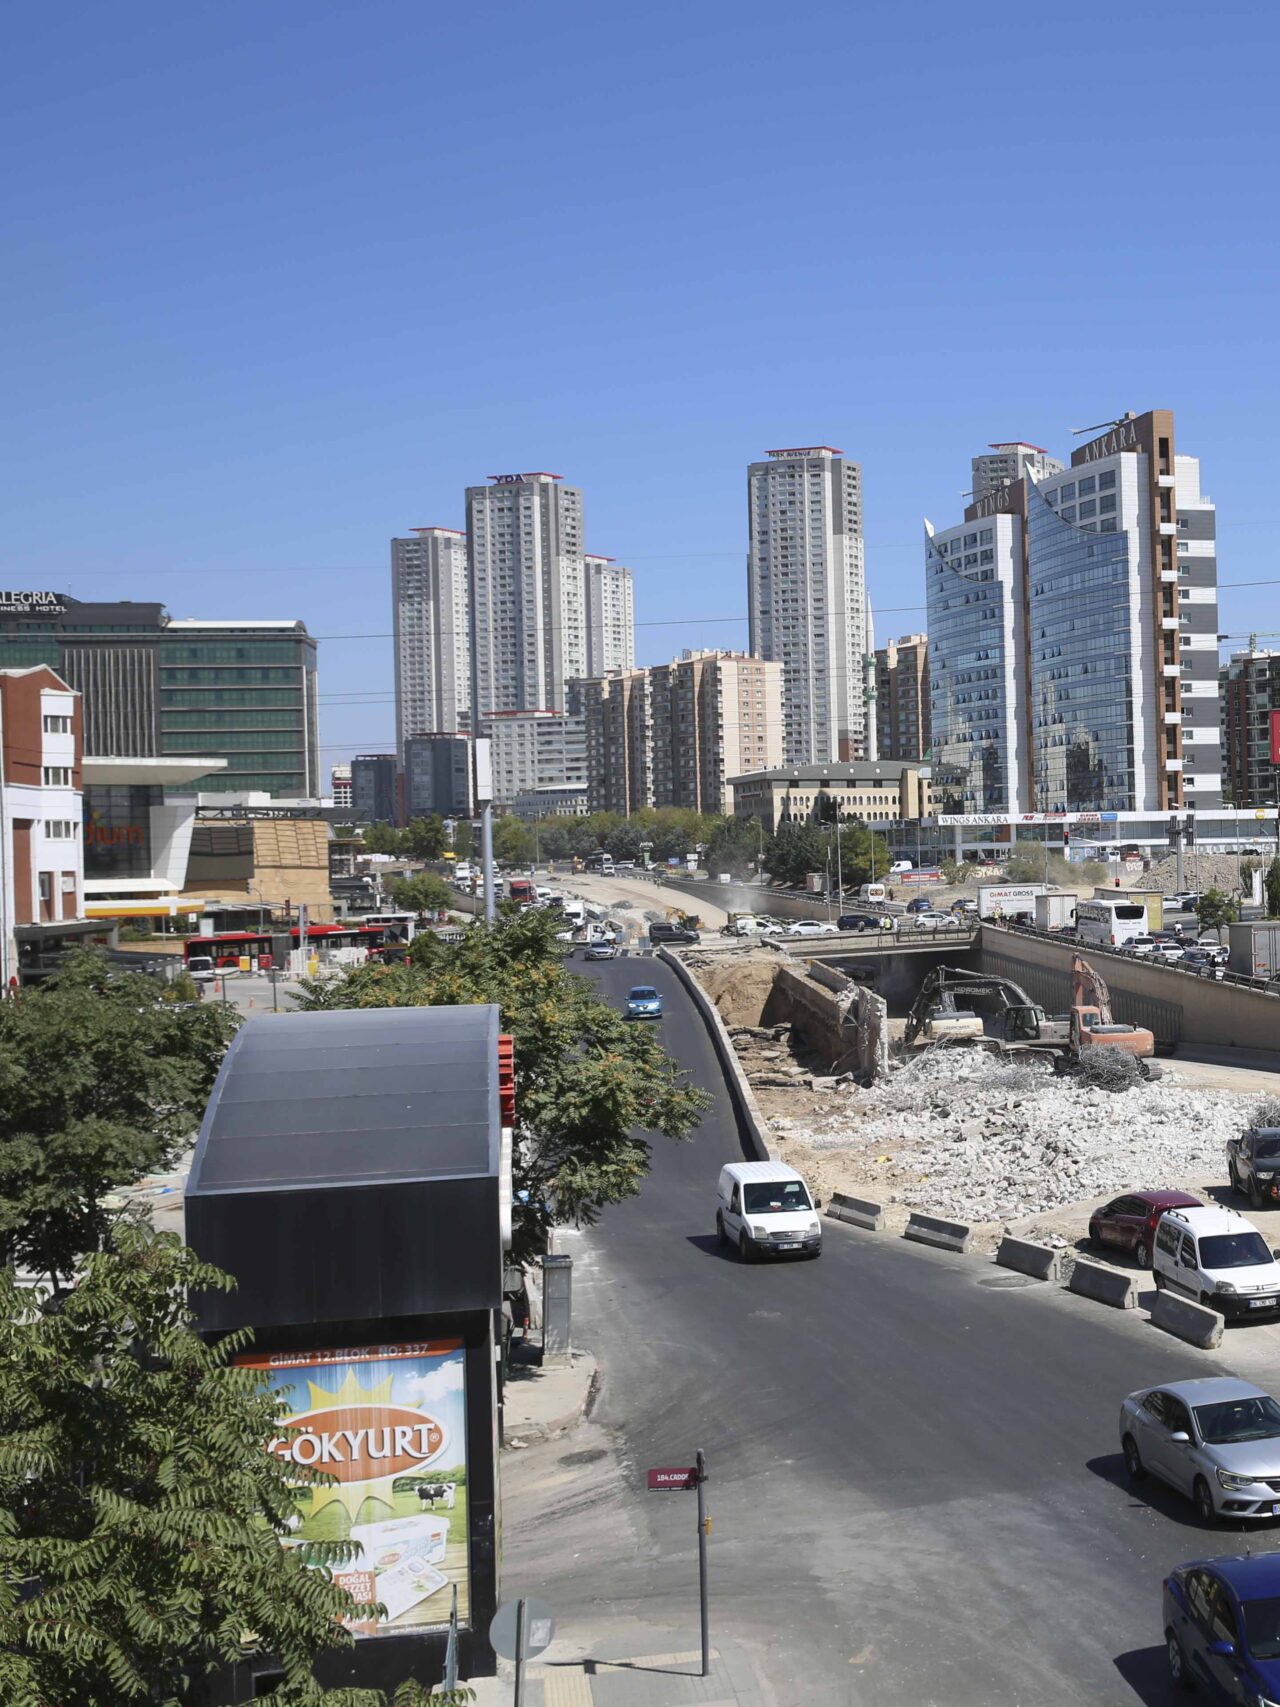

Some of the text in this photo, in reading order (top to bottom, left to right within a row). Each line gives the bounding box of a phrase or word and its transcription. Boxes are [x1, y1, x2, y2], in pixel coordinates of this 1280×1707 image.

[1085, 421, 1137, 463] ANKARA
[495, 474, 525, 484] YDA
[976, 488, 1010, 519] WINGS
[941, 815, 1009, 825] WINGS ANKARA
[269, 1344, 428, 1366] GİMAT 12.BLOK NO: 337
[267, 1423, 436, 1466] GÖKYURT
[339, 1572, 371, 1583] DOĞAL
[344, 1582, 371, 1592] EZZET
[352, 1591, 372, 1601] TASI
